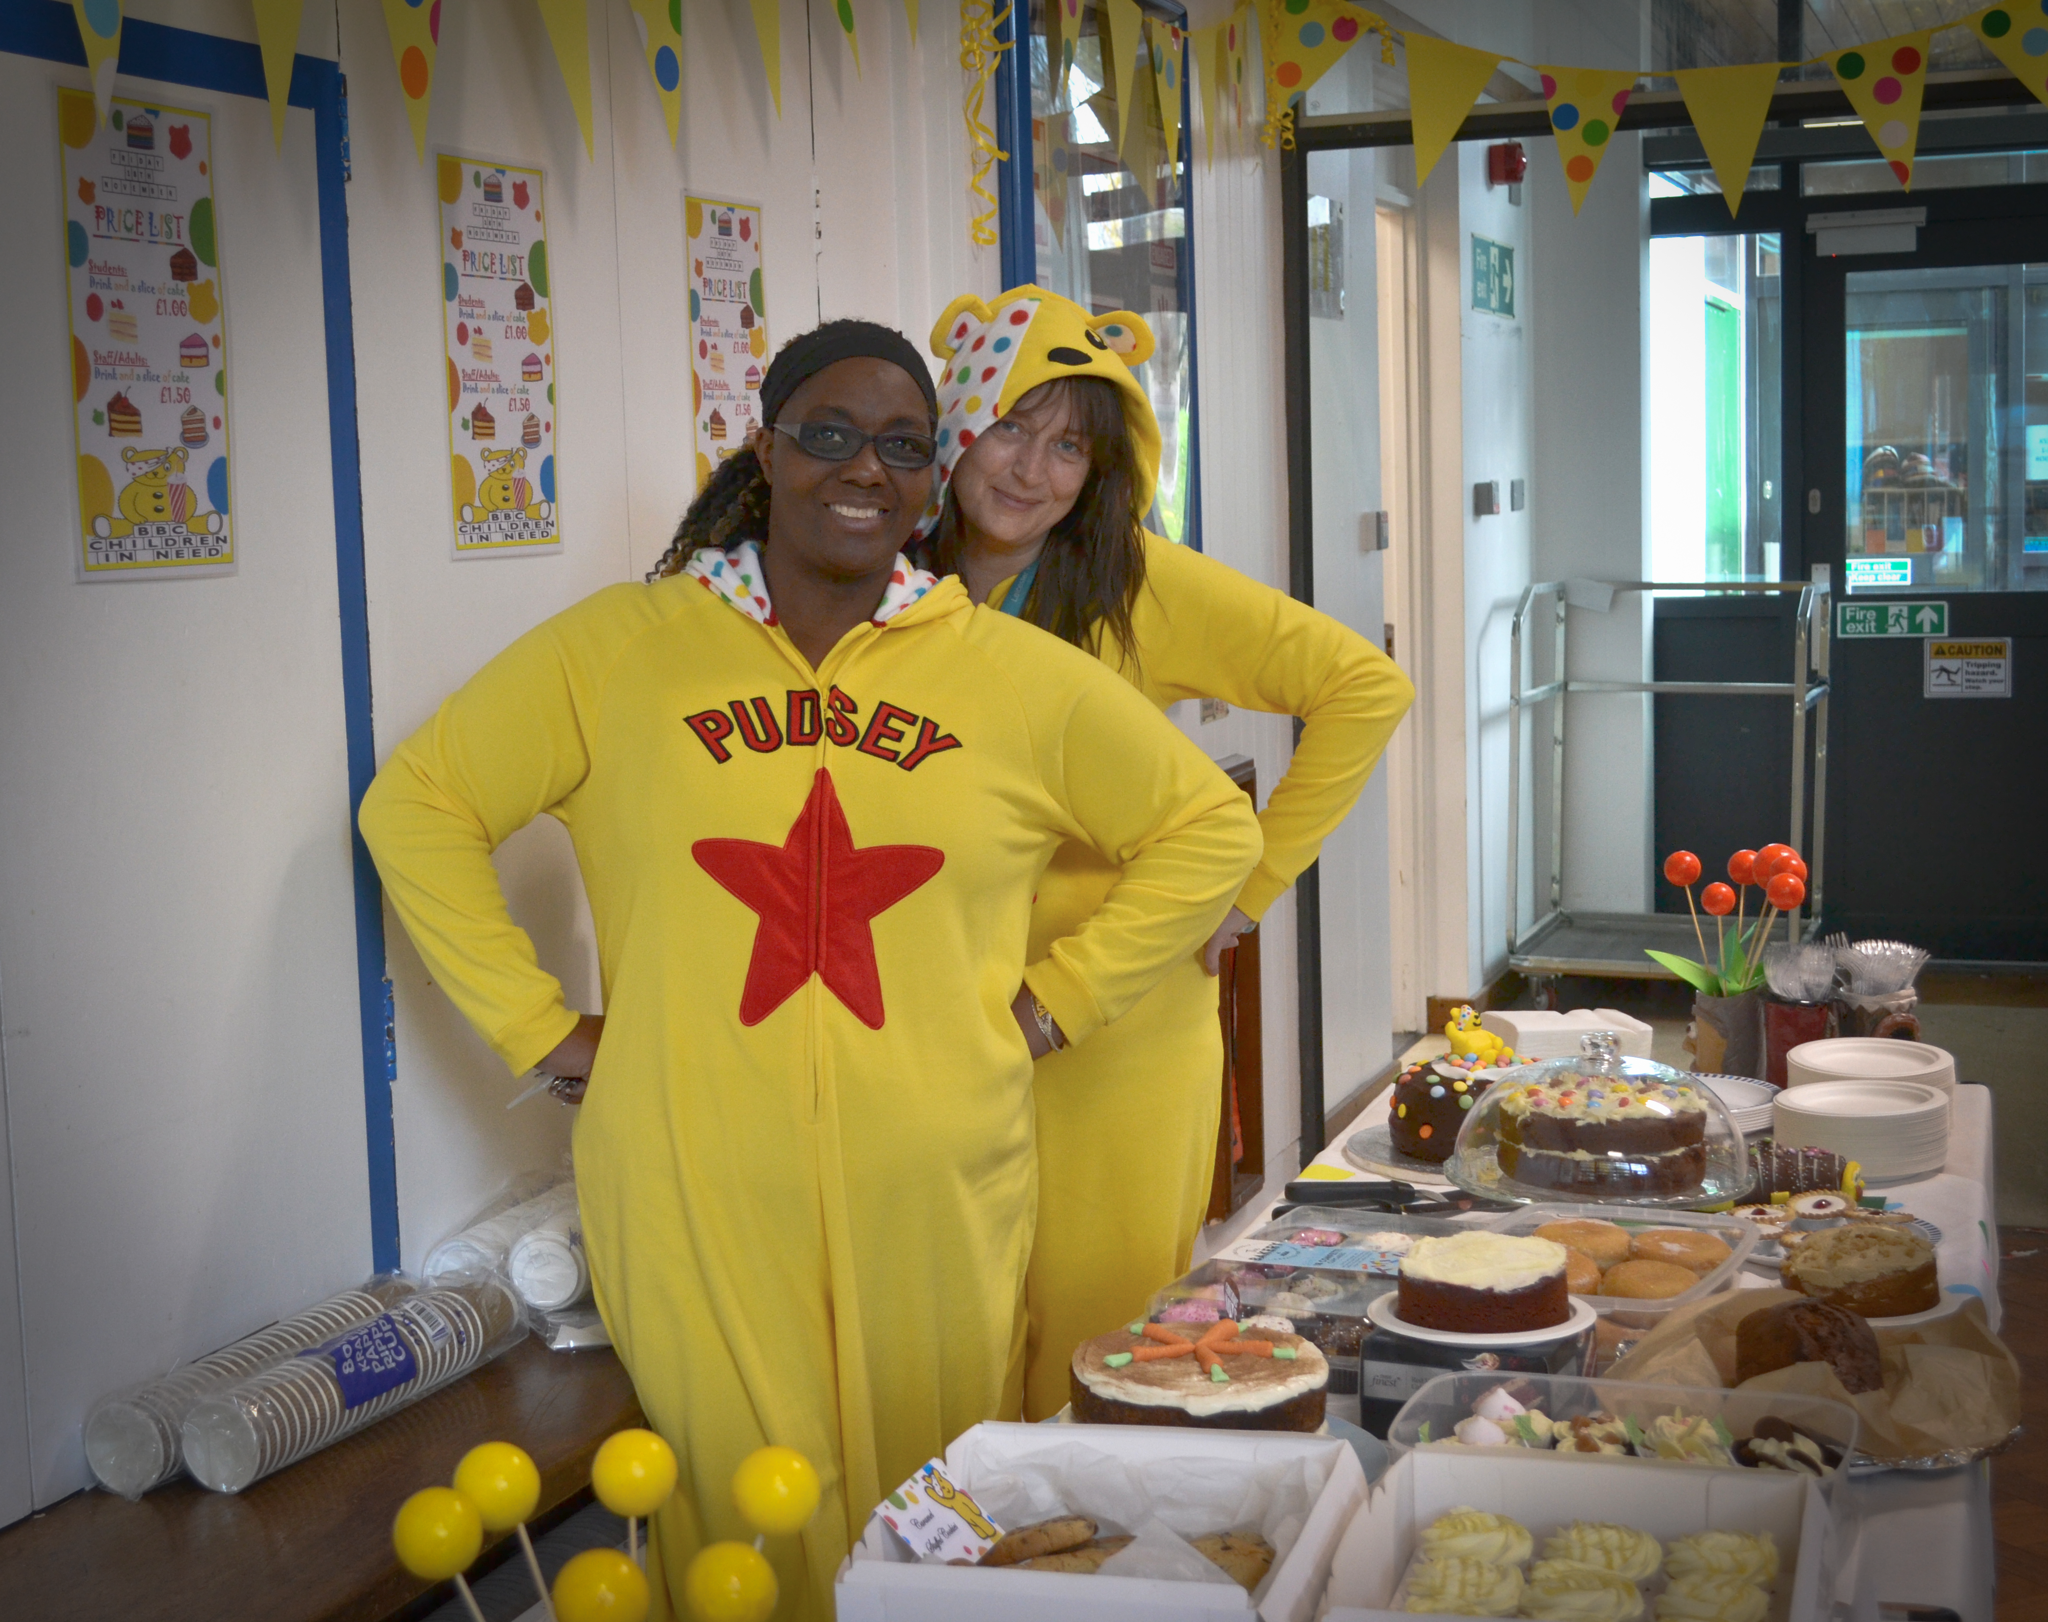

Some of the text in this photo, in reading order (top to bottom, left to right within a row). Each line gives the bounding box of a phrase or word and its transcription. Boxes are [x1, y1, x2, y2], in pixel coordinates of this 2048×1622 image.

[94, 205, 184, 240] PRICE LIST
[462, 250, 525, 276] PRICE LIST
[89, 276, 185, 296] Drink and a slice of cake
[156, 299, 188, 317] £1.00
[94, 367, 190, 384] Drink and a slice of cake
[160, 386, 191, 404] £1.50
[492, 513, 523, 521] BBC
[138, 526, 184, 536] BBC
[459, 520, 554, 532] CHILDREN
[89, 535, 228, 550] CHILDREN
[470, 531, 549, 542] IN NEED
[104, 547, 220, 562] IN NEED
[1851, 562, 1892, 570] Fire exit
[1851, 573, 1901, 582] Keep clear
[1846, 607, 1876, 620] Fire
[1846, 621, 1876, 633] exit
[1948, 645, 2002, 655] CAUTION
[683, 684, 963, 771] PUDSEY
[378, 1319, 406, 1361] CUP
